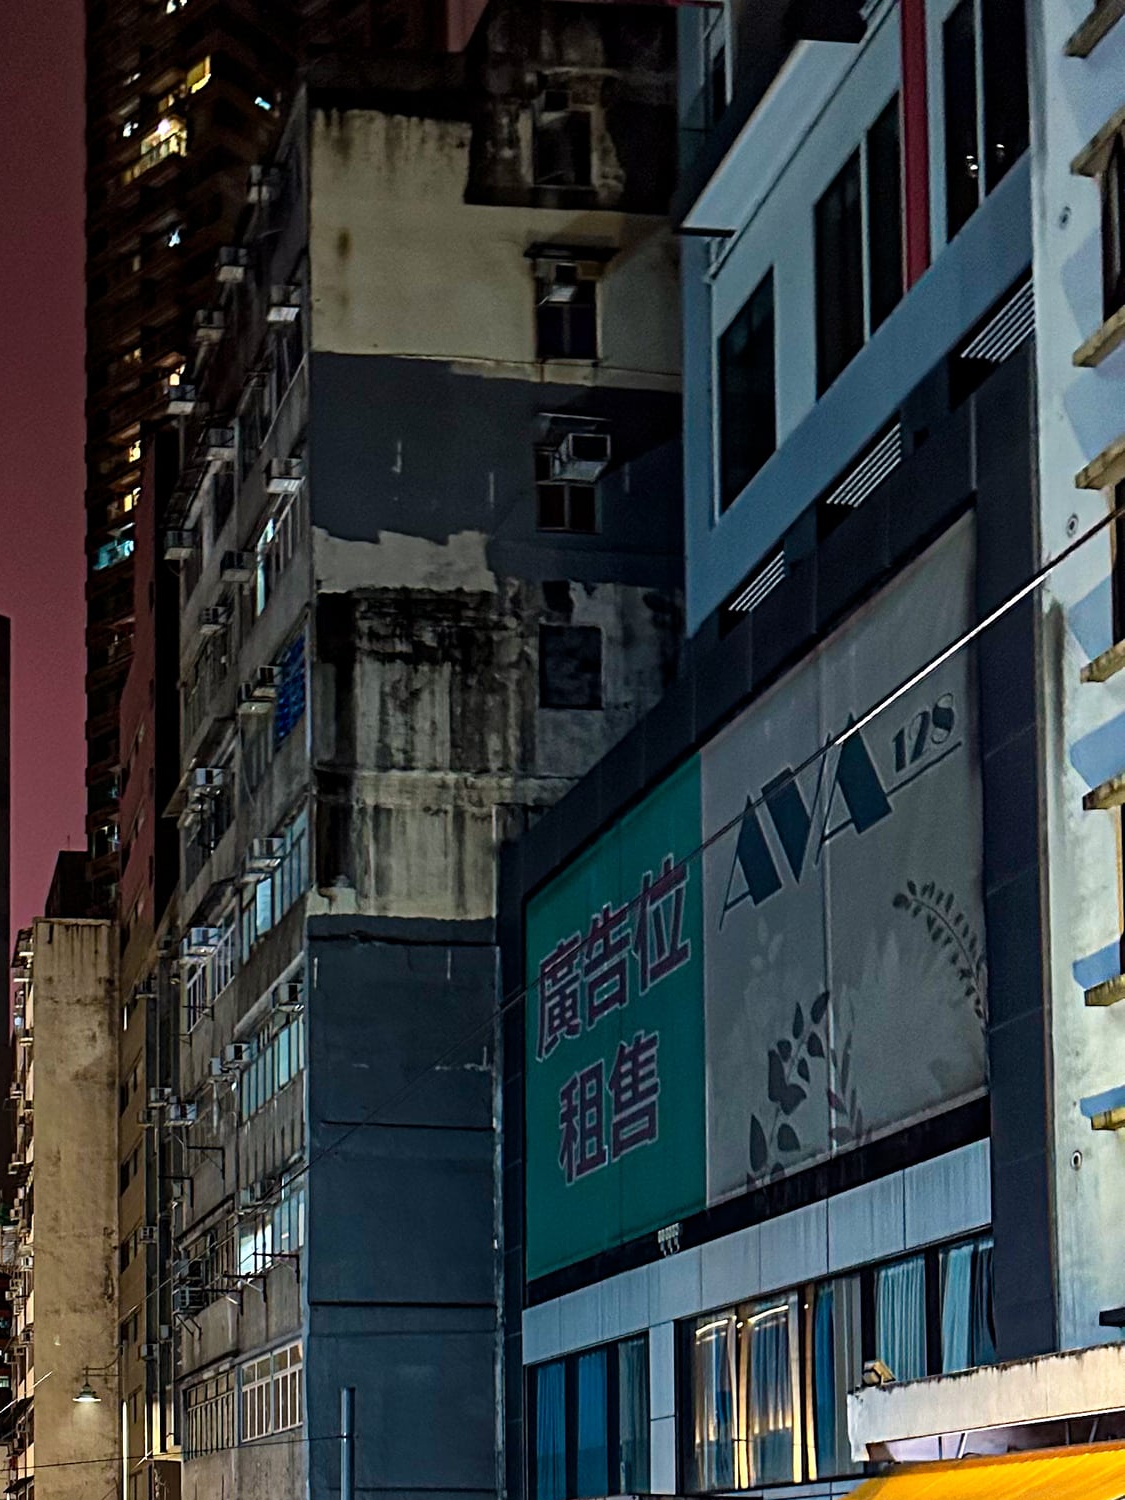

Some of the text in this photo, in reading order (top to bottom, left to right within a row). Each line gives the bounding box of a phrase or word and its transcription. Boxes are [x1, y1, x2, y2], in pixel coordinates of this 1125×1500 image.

[719, 712, 893, 930] AVA
[535, 852, 693, 1063] 廣告位
[558, 1031, 662, 1187] 租售
